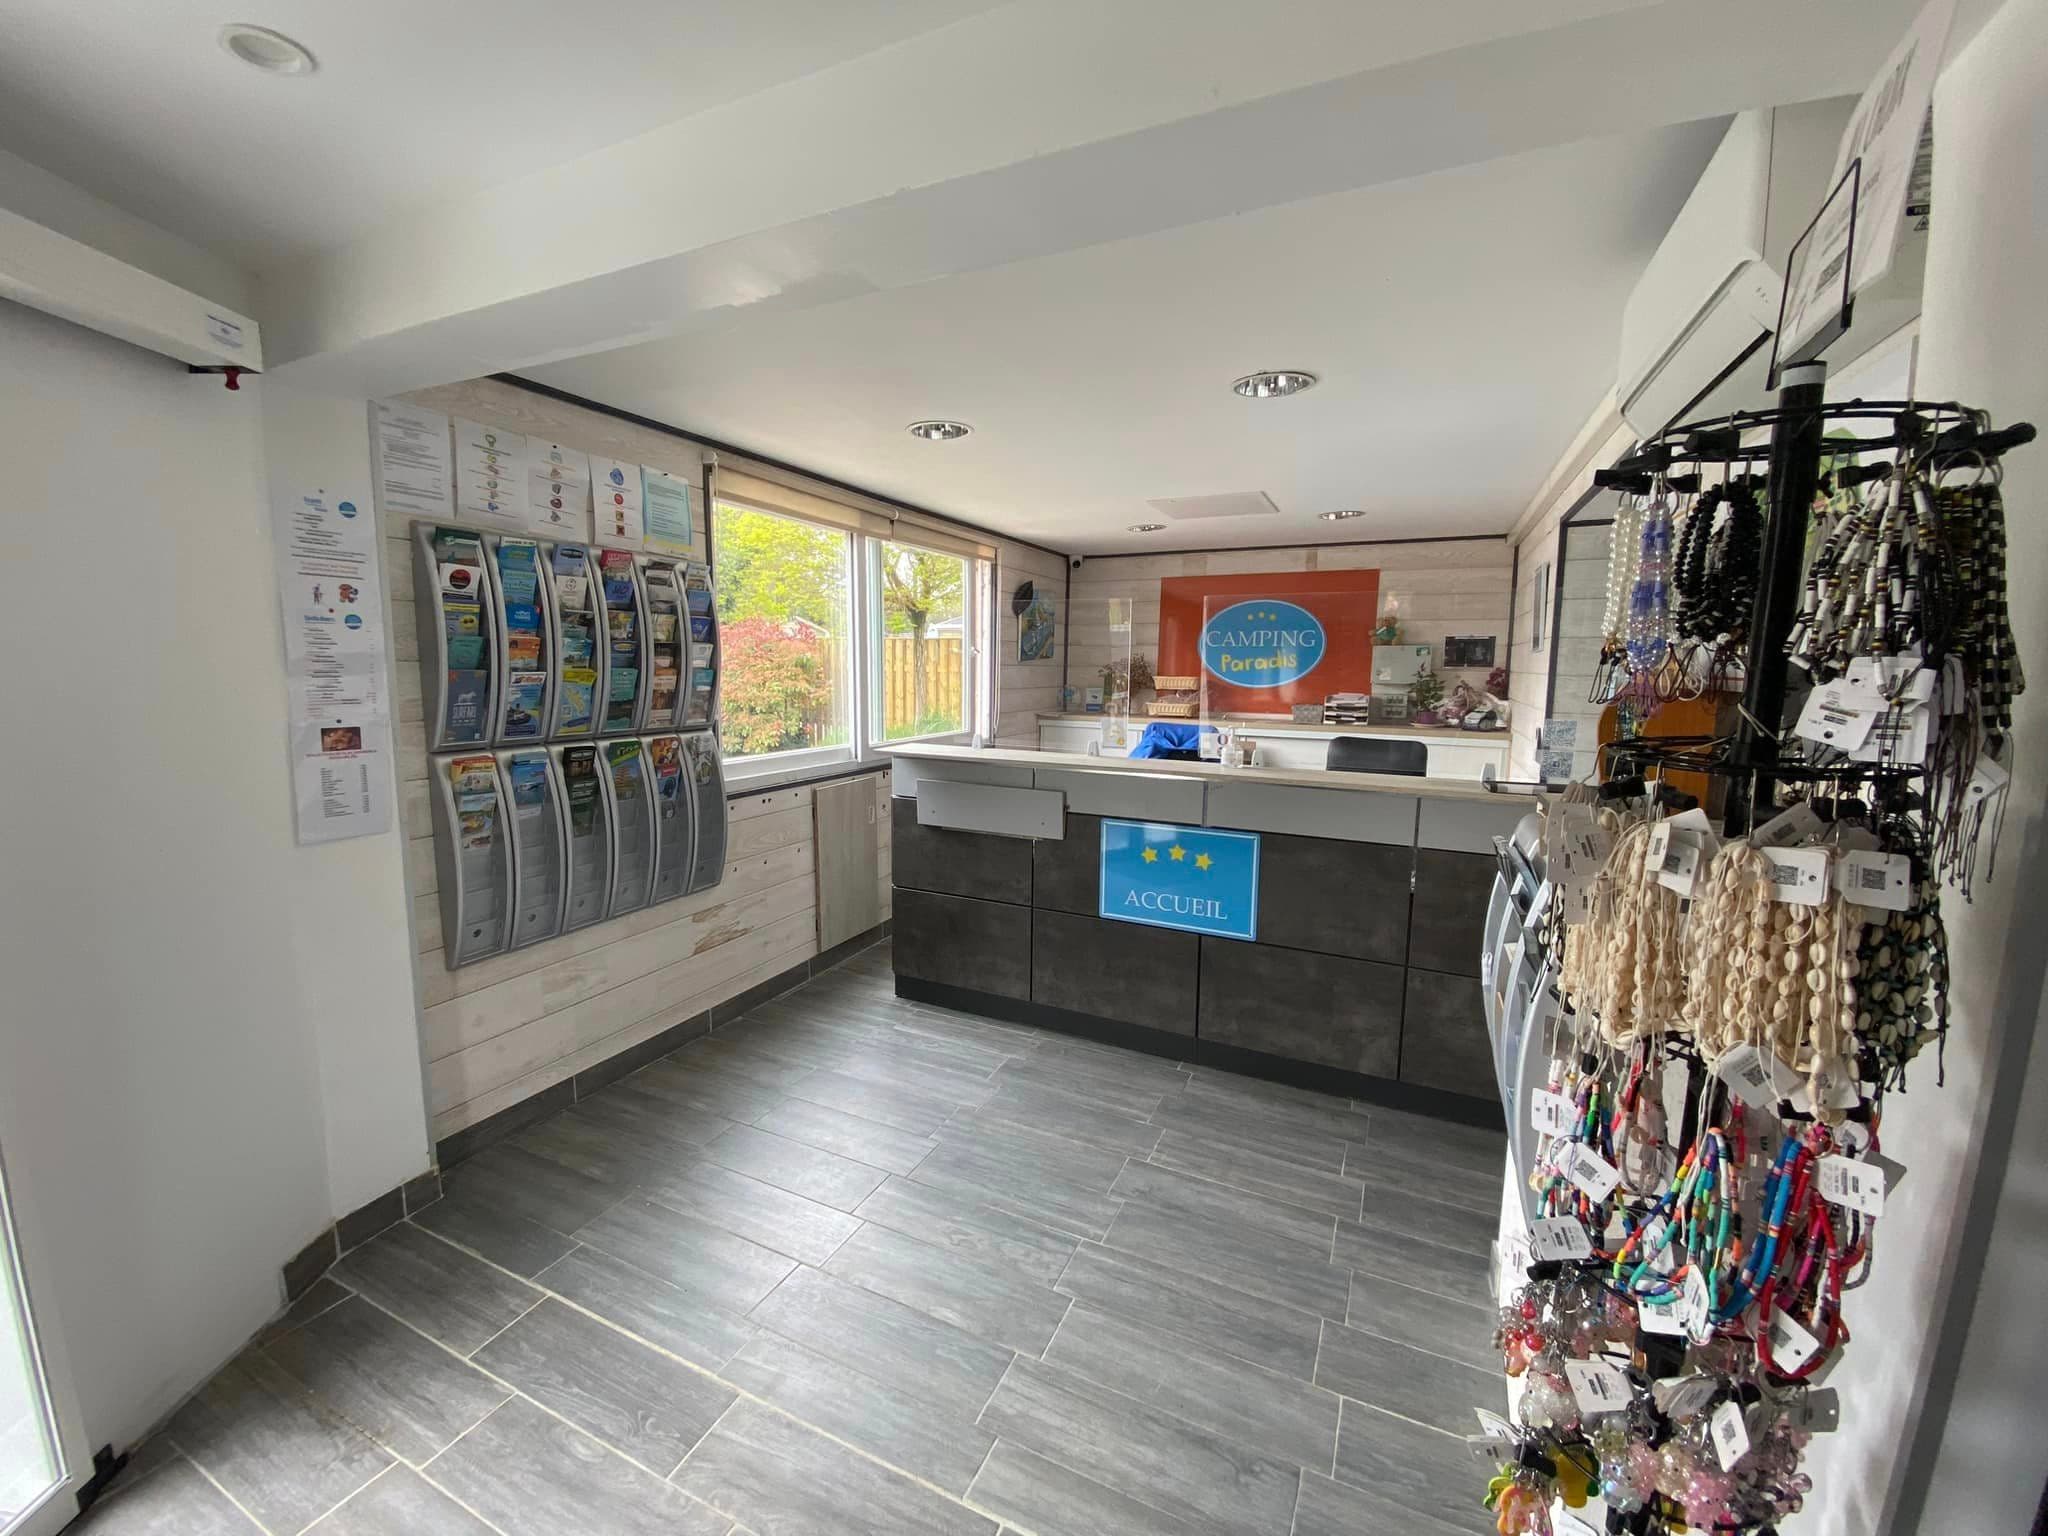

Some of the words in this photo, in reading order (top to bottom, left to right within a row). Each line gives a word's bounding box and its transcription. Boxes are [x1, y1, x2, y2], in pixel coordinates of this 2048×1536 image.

[1206, 629, 1317, 648] CAMPING
[1221, 648, 1297, 673] Paradis
[1124, 888, 1228, 920] ACCUEIL
